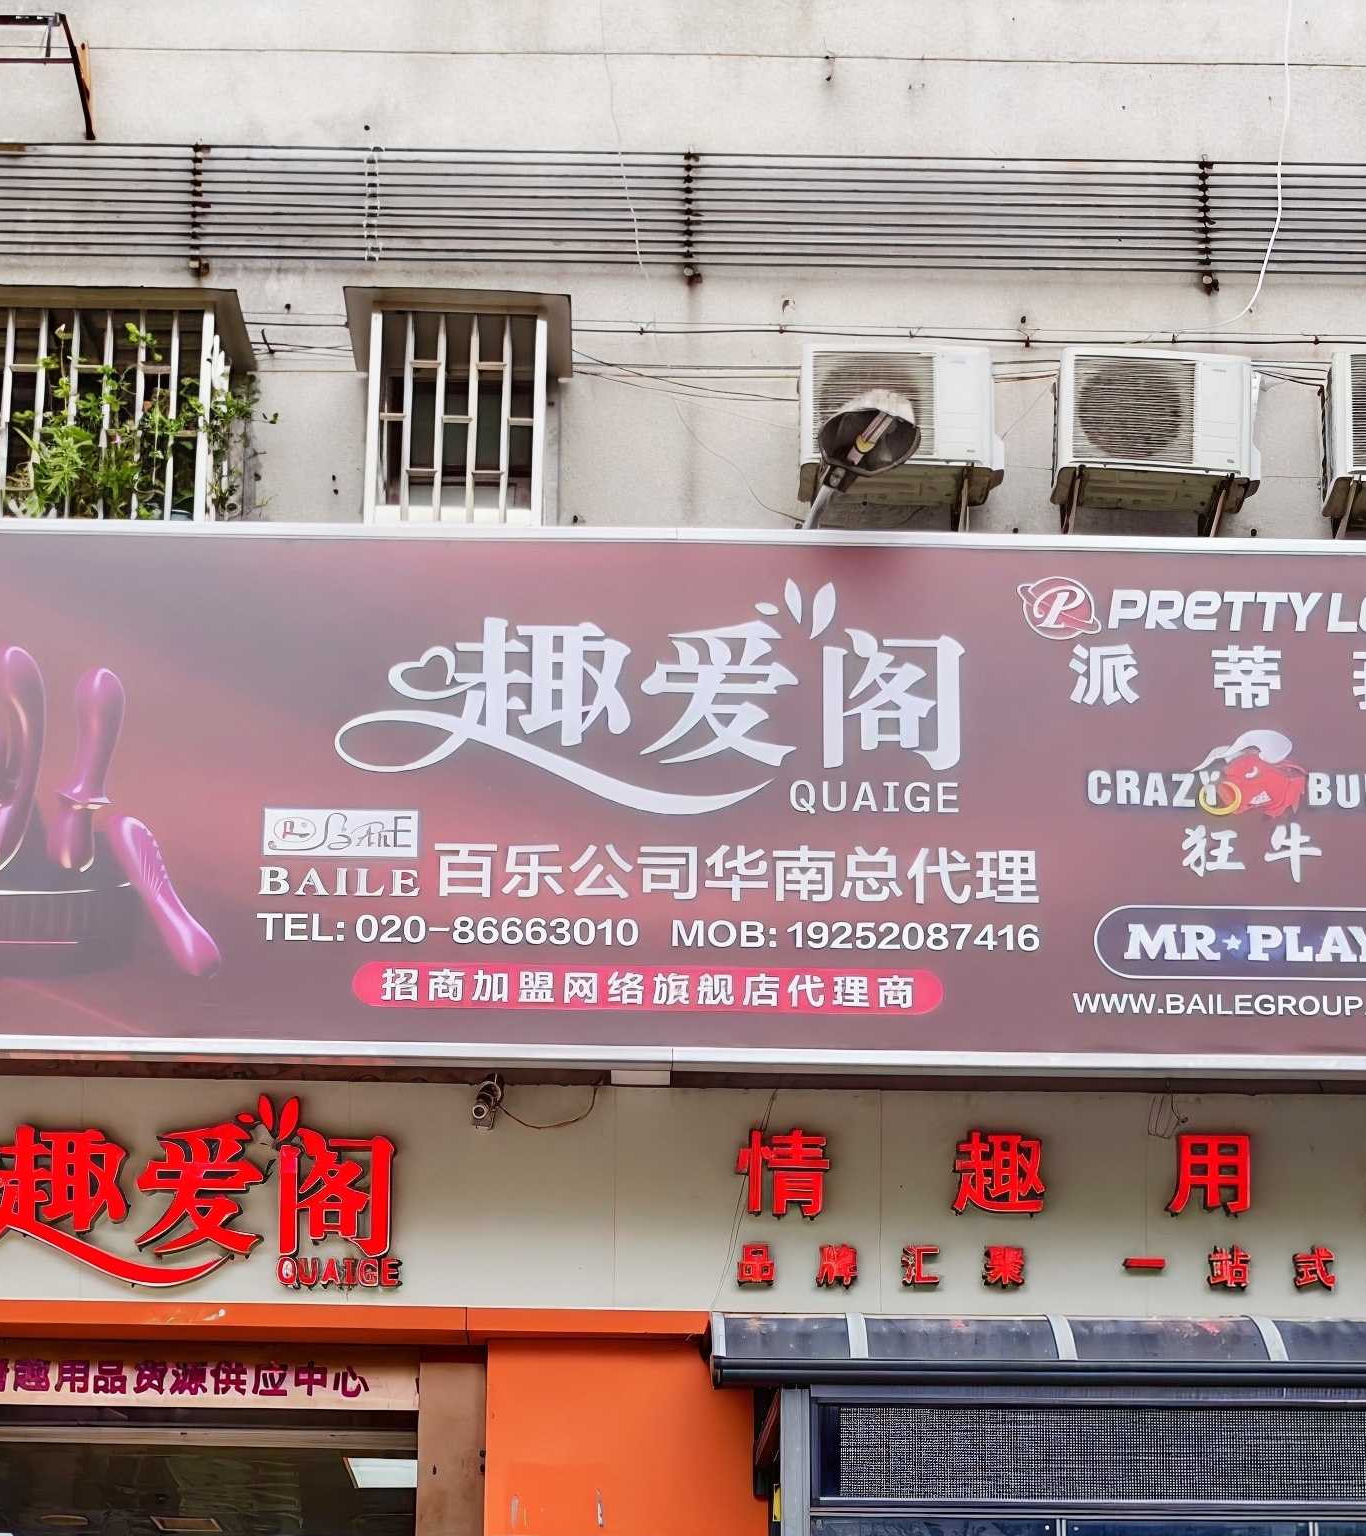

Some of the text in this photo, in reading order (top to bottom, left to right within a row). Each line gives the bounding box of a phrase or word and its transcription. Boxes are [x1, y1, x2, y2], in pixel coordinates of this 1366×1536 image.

[334, 616, 967, 815] 趣爱阁
[789, 780, 960, 814] QUAIGE
[1087, 769, 1221, 808] CRAZY
[1181, 822, 1323, 883] 狂牛
[257, 866, 421, 897] BAILE
[435, 842, 1040, 905] 百乐公司华南总代理
[355, 914, 639, 947] 020-86663010
[786, 920, 1040, 952] 19252087416
[381, 968, 914, 1009] 招商加盟网络旗舰店代理商
[276, 1256, 401, 1288] QUAIGE
